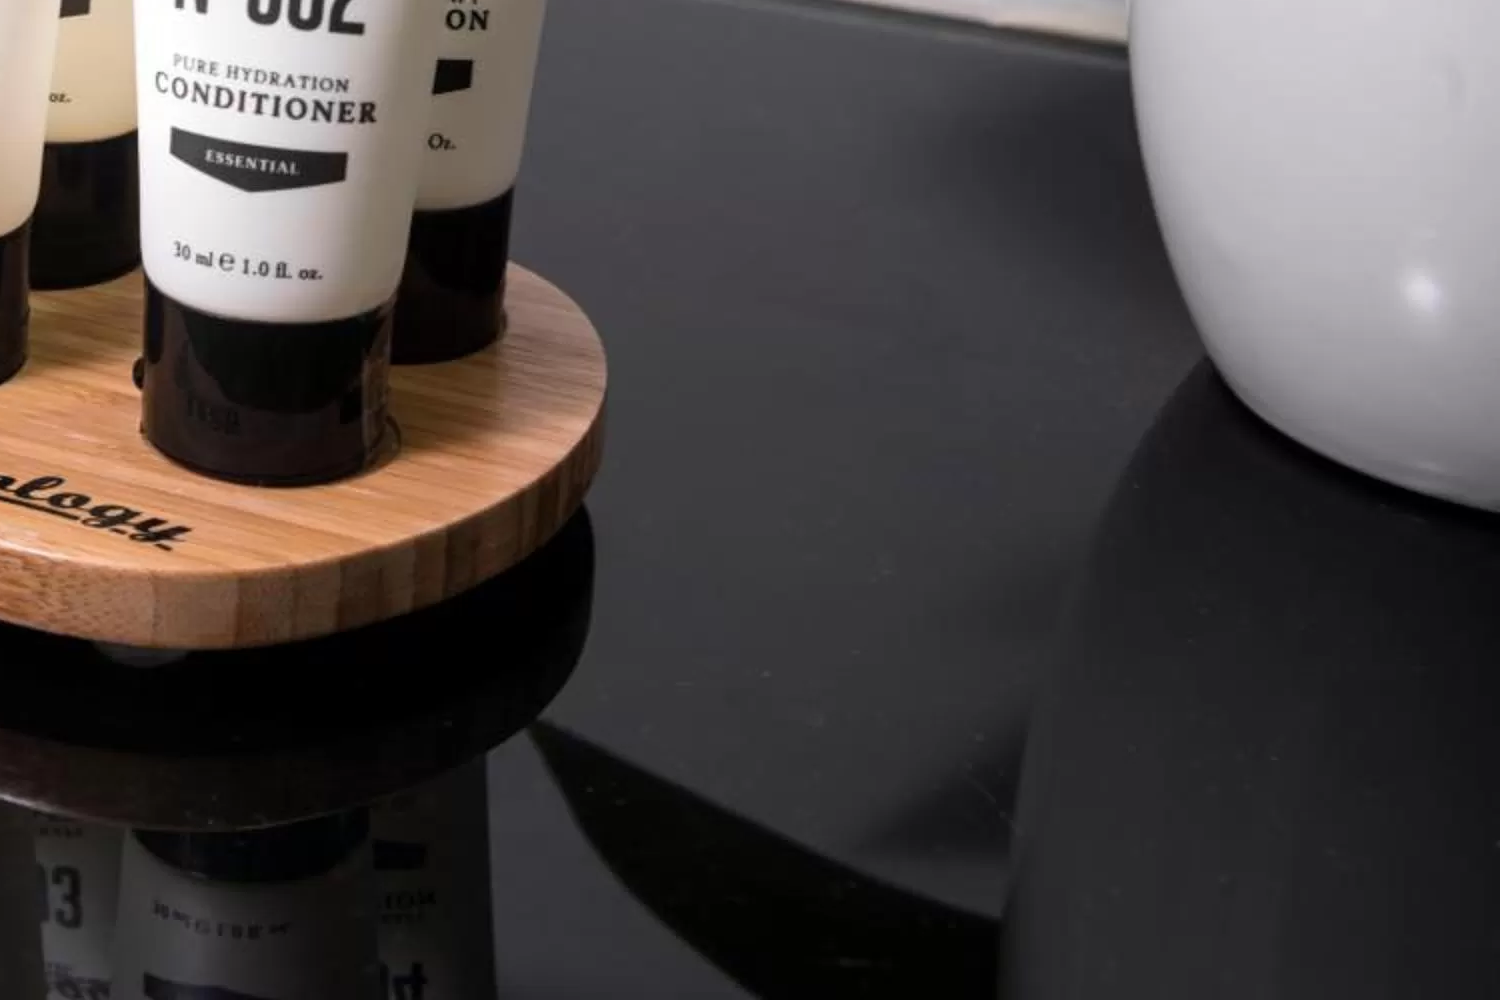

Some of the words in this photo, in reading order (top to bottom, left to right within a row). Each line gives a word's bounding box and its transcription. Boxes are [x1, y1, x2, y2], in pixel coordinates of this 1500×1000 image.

[172, 53, 220, 77] PURE
[226, 64, 350, 93] HYDRATION
[155, 71, 378, 124] CONDITIONER
[204, 149, 300, 175] ESSENTIAL
[242, 256, 270, 277] 1.0
